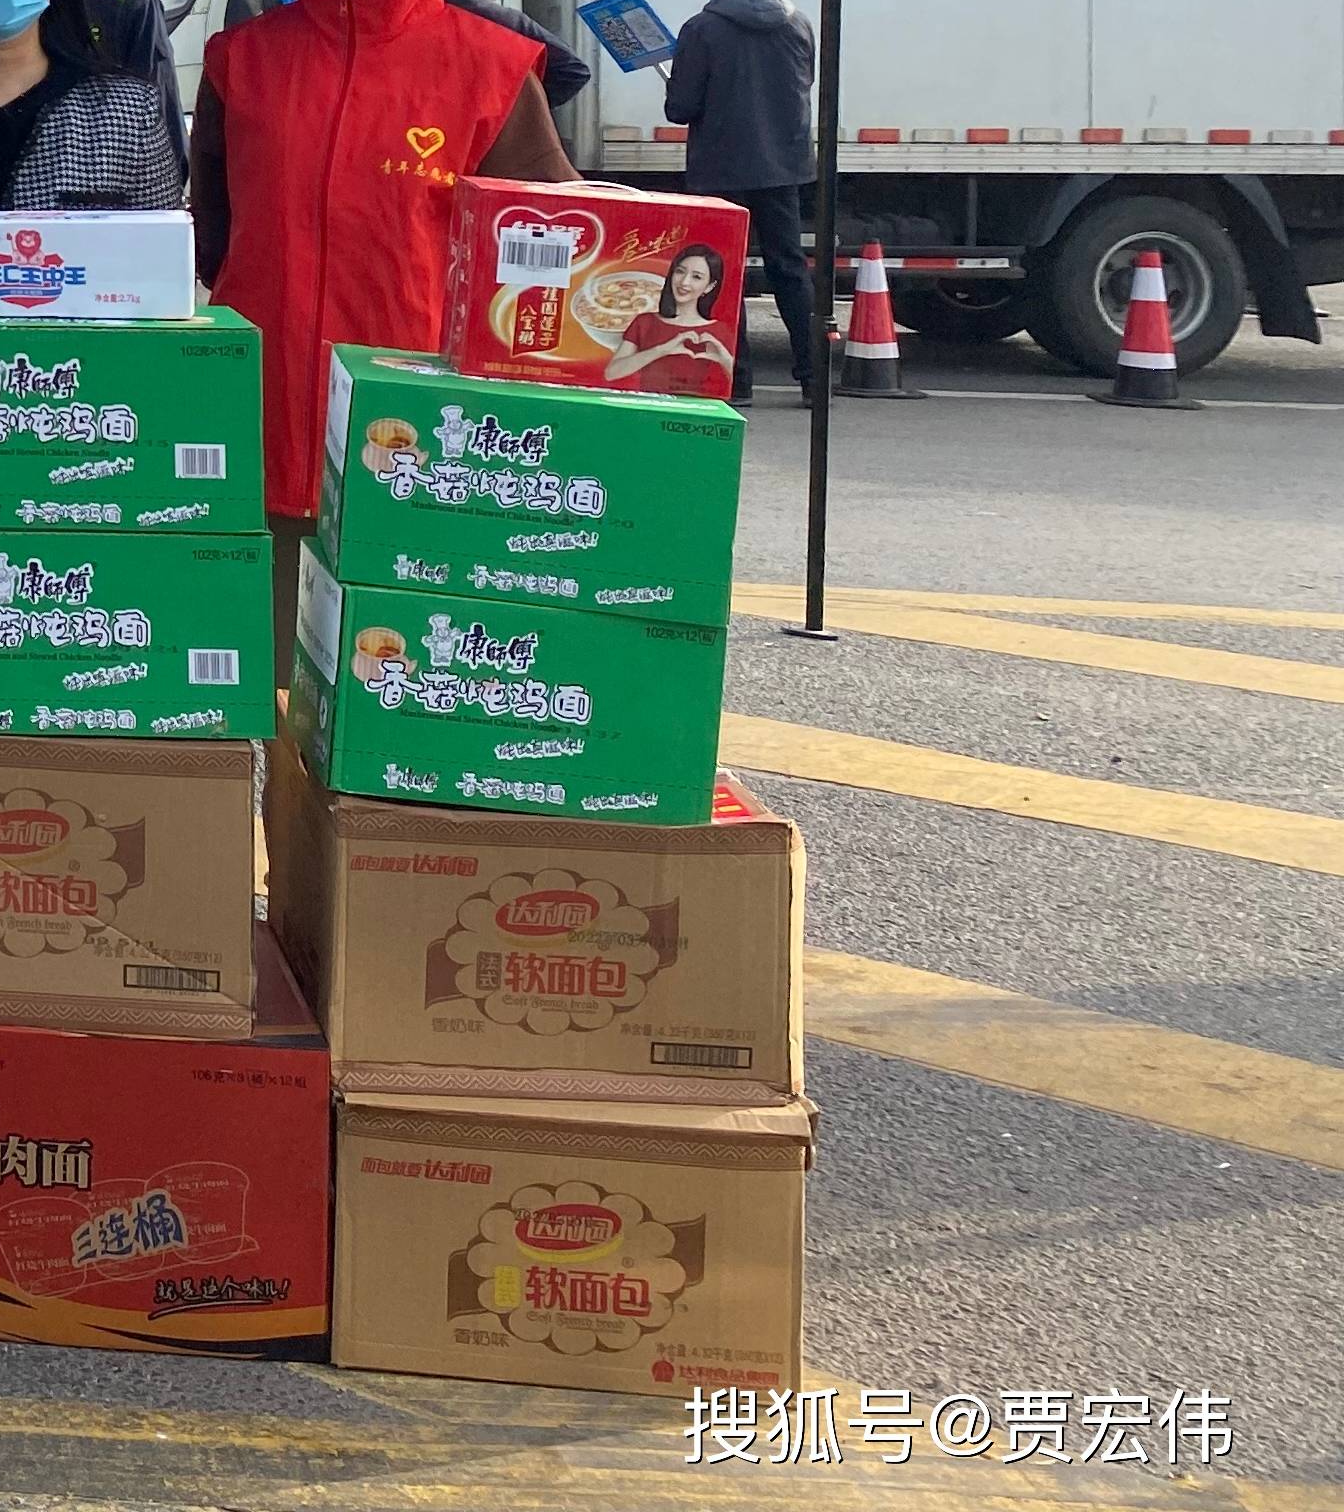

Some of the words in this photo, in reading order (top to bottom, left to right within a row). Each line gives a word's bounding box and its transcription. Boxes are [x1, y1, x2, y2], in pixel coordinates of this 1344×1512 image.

[518, 304, 537, 346] 八宝粥
[377, 452, 608, 518] 香菇炖鸡面
[367, 660, 593, 725] 香菇炖鸡面
[505, 898, 595, 928] 达利园
[505, 954, 627, 998] 软面包
[72, 1192, 184, 1264] 三连桶
[527, 1214, 615, 1243] 达利园
[525, 1266, 652, 1317] 软面包
